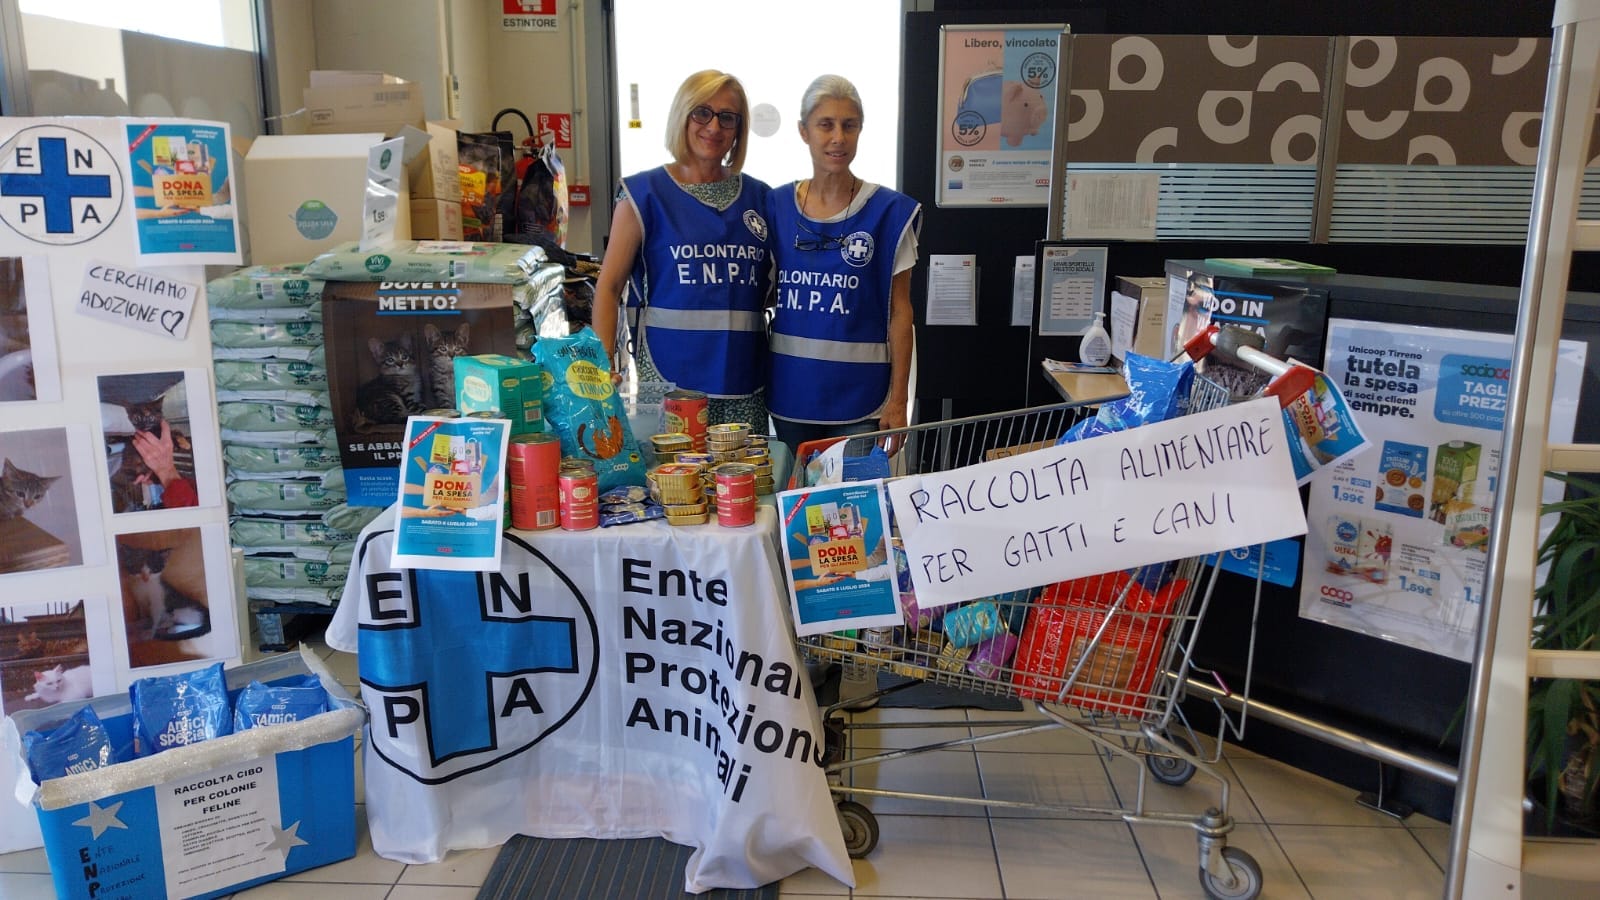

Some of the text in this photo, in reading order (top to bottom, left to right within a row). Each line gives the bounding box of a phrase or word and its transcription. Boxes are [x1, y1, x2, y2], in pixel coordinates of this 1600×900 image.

[503, 18, 557, 27] ESTINTORE
[964, 38, 1003, 49] Libero,
[1027, 66, 1049, 79] 5%
[958, 123, 979, 136] 5%
[15, 147, 93, 168] E N
[162, 181, 204, 190] DONA
[20, 203, 102, 223] P A
[669, 244, 765, 262] VOLONTARIO
[89, 266, 187, 300] CERCHIAMO
[778, 270, 859, 289] OLONTARIO
[80, 288, 159, 324] ADOZIONE
[379, 296, 458, 311] METTO?
[1241, 299, 1264, 318] IN
[1348, 345, 1423, 360] Unicoop Tirreno
[1346, 355, 1421, 380] tutela
[1344, 372, 1418, 395] la spesa
[1343, 390, 1417, 406] di soci e clienti
[1300, 394, 1317, 434] DONA
[349, 442, 403, 452] SE ABBA
[373, 452, 385, 460] IL
[908, 417, 1275, 523] RACCOLTA ALIMENTARE
[434, 480, 473, 491] DONA
[1332, 485, 1365, 505] 1,99€
[920, 493, 1235, 584] PER GATTI E CANI
[817, 545, 858, 558] DONA
[622, 558, 728, 607] Ente
[366, 572, 532, 620] E N
[1320, 585, 1354, 602] coop
[383, 677, 544, 739] P A
[625, 697, 752, 803] Animali
[174, 766, 263, 796] RACCOLTA CIBO
[183, 781, 257, 807] PER COLONIE
[202, 798, 241, 814] FELINE
